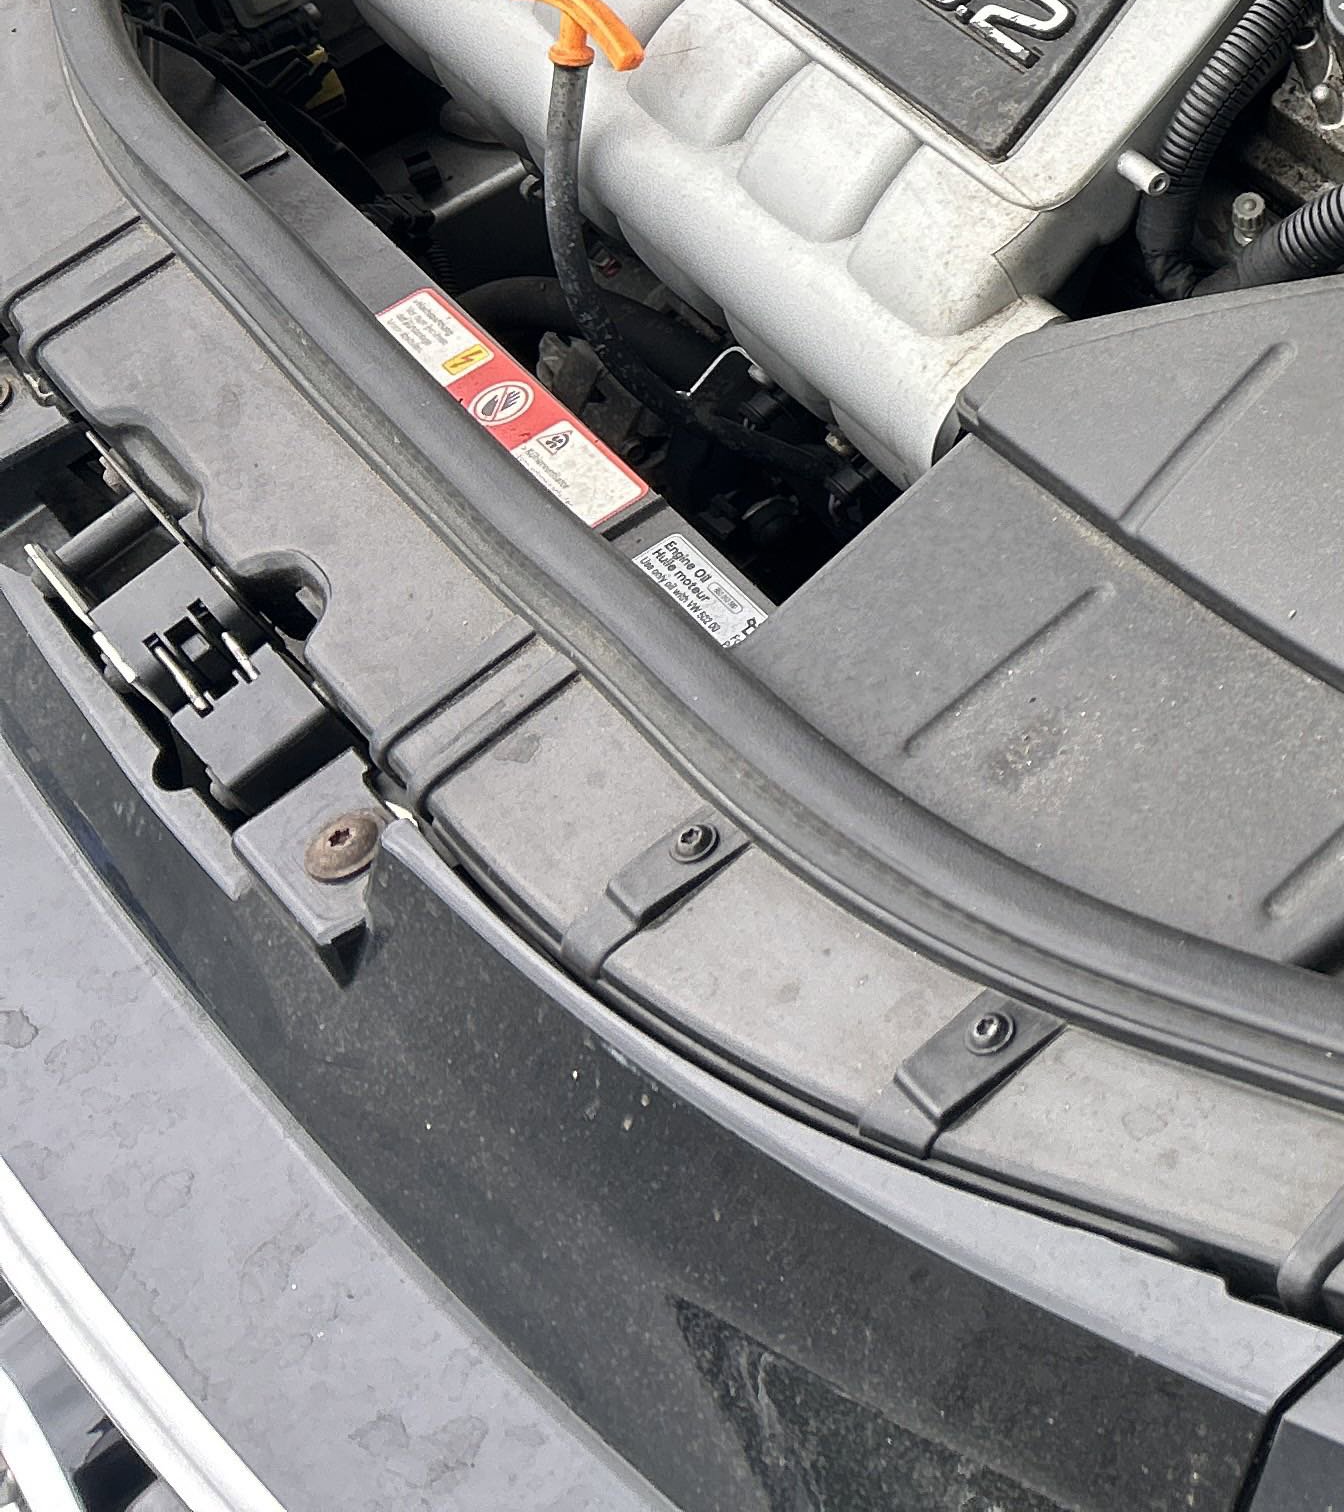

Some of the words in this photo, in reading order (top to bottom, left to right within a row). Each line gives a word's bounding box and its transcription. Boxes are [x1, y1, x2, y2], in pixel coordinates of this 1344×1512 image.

[652, 548, 677, 572] Huile
[674, 570, 711, 602] moteur
[664, 540, 696, 571] Engine
[694, 568, 713, 584] Oil
